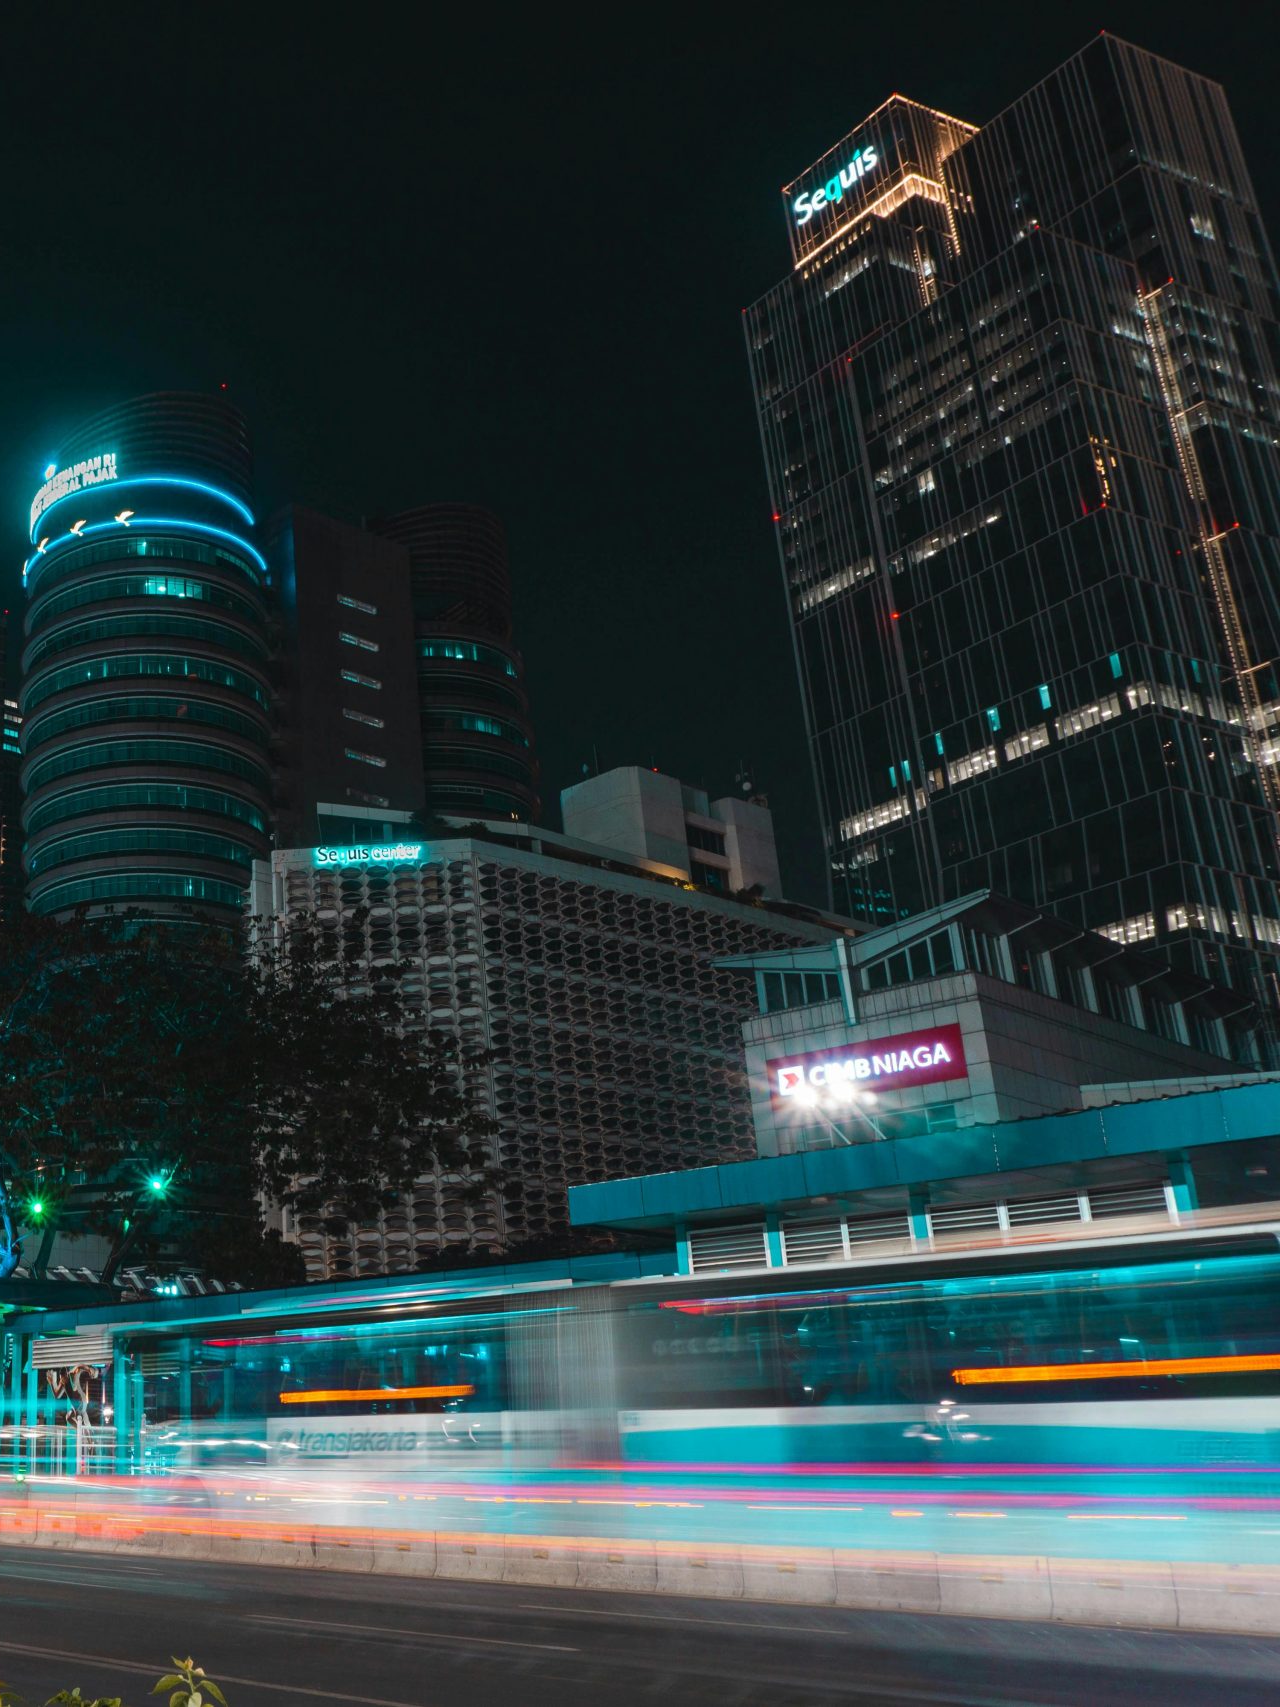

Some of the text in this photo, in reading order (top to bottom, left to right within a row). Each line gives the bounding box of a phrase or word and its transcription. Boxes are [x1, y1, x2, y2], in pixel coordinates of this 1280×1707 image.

[794, 145, 878, 225] Sequis
[83, 466, 118, 486] PAJAK
[809, 1043, 951, 1087] CIMB NIAGA
[299, 1427, 417, 1456] transjakarta
